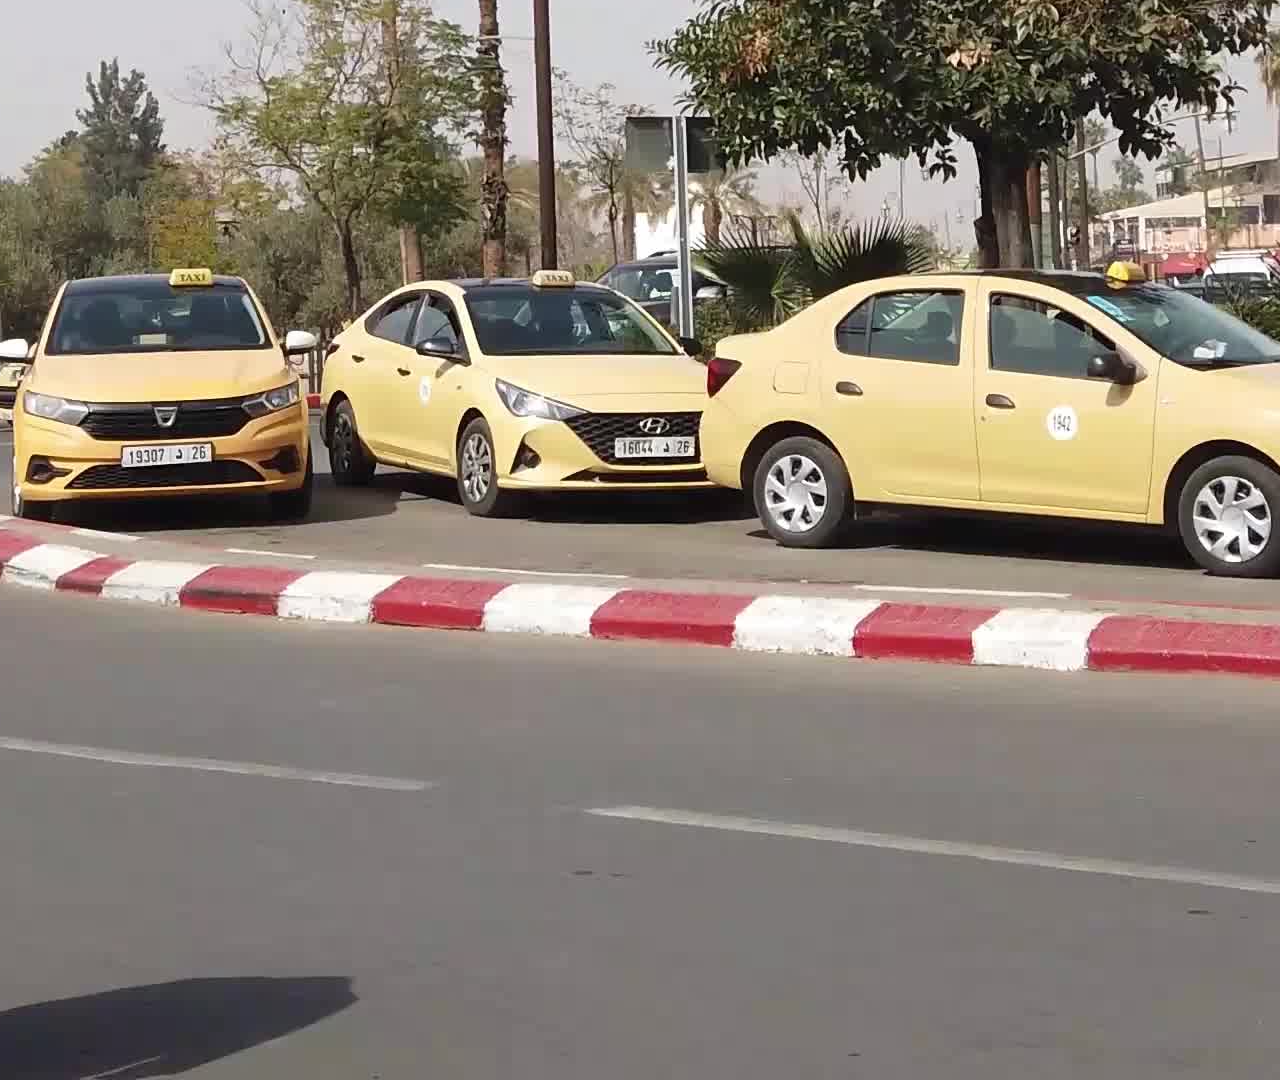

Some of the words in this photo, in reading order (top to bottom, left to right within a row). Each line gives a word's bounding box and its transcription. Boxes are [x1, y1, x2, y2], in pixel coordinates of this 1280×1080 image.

[180, 274, 206, 282] TAXI
[1053, 414, 1072, 432] 1942
[129, 448, 165, 464] 19307
[192, 445, 206, 460] 26
[622, 440, 653, 455] 16044
[676, 440, 690, 454] 26
